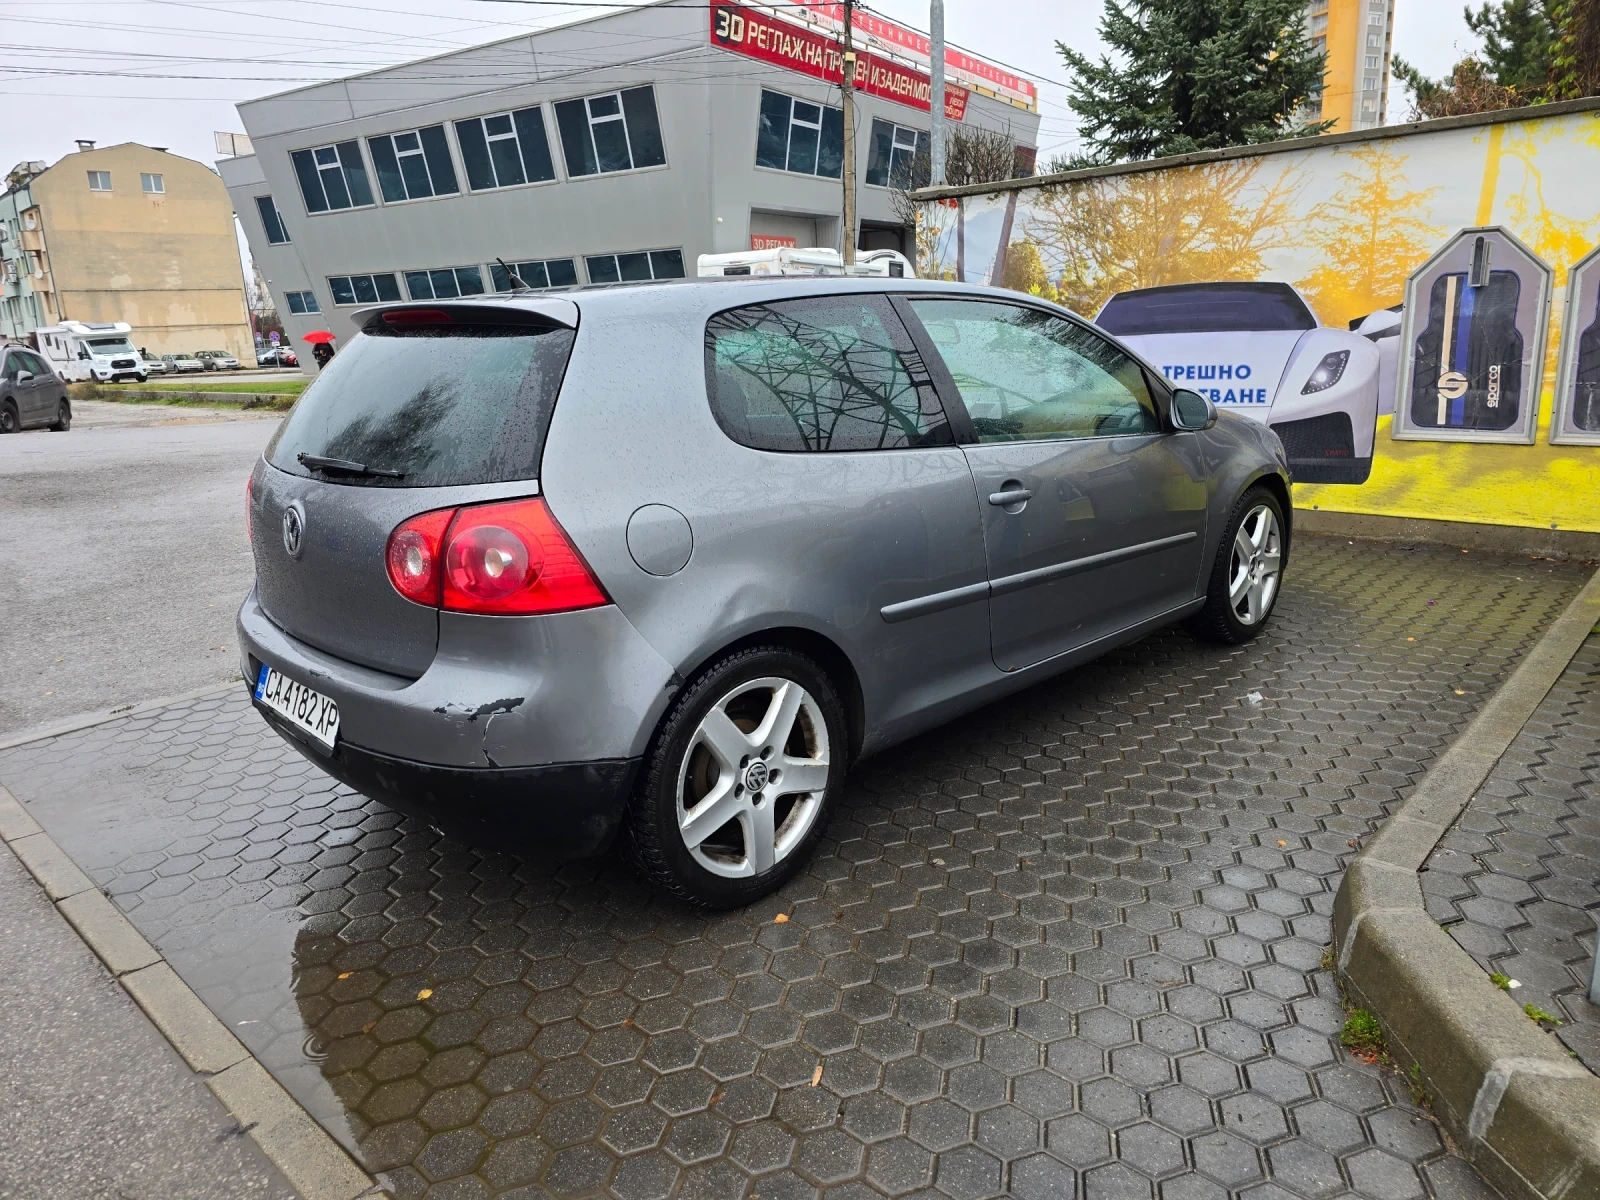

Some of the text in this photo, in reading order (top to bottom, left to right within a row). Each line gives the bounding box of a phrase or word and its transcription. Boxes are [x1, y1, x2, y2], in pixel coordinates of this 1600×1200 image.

[716, 9, 745, 43] 3D
[747, 20, 805, 62] РЕГЛАЖ
[805, 41, 823, 68] НА
[823, 48, 868, 81] ПРЕЕН
[913, 80, 931, 103] МОС
[858, 15, 947, 60] ТЕХНИЧЕС
[961, 57, 1014, 87] ПРЕГЛЕДИ
[753, 239, 764, 250] 3D
[1162, 364, 1252, 380] ТРЕШНО
[1487, 365, 1500, 408] sparco
[1198, 388, 1267, 404] ТВАНЕ
